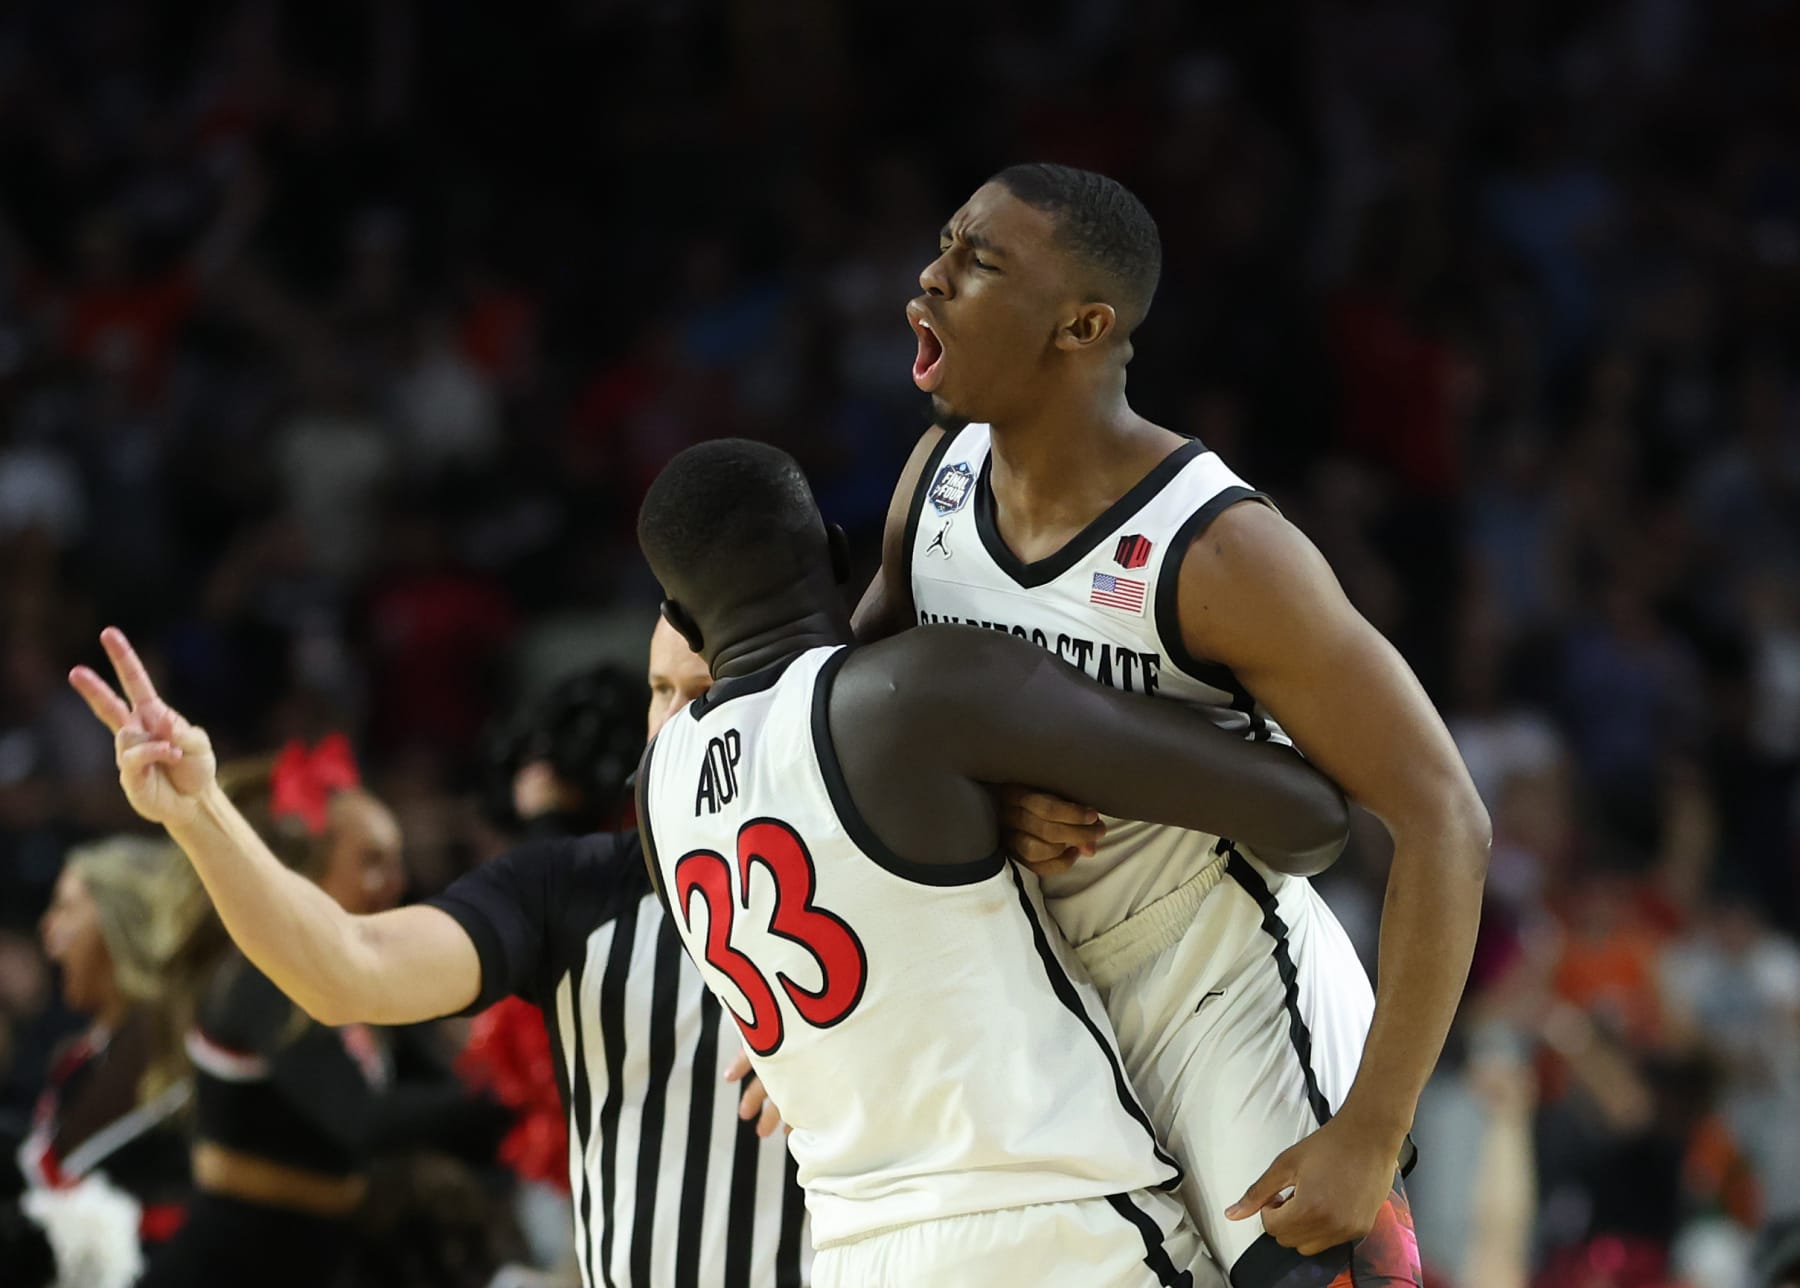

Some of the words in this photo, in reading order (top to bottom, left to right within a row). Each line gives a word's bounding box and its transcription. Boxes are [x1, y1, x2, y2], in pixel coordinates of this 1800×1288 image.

[942, 471, 970, 491] FINAL
[937, 484, 965, 505] FOUR
[675, 816, 868, 1057] 33
